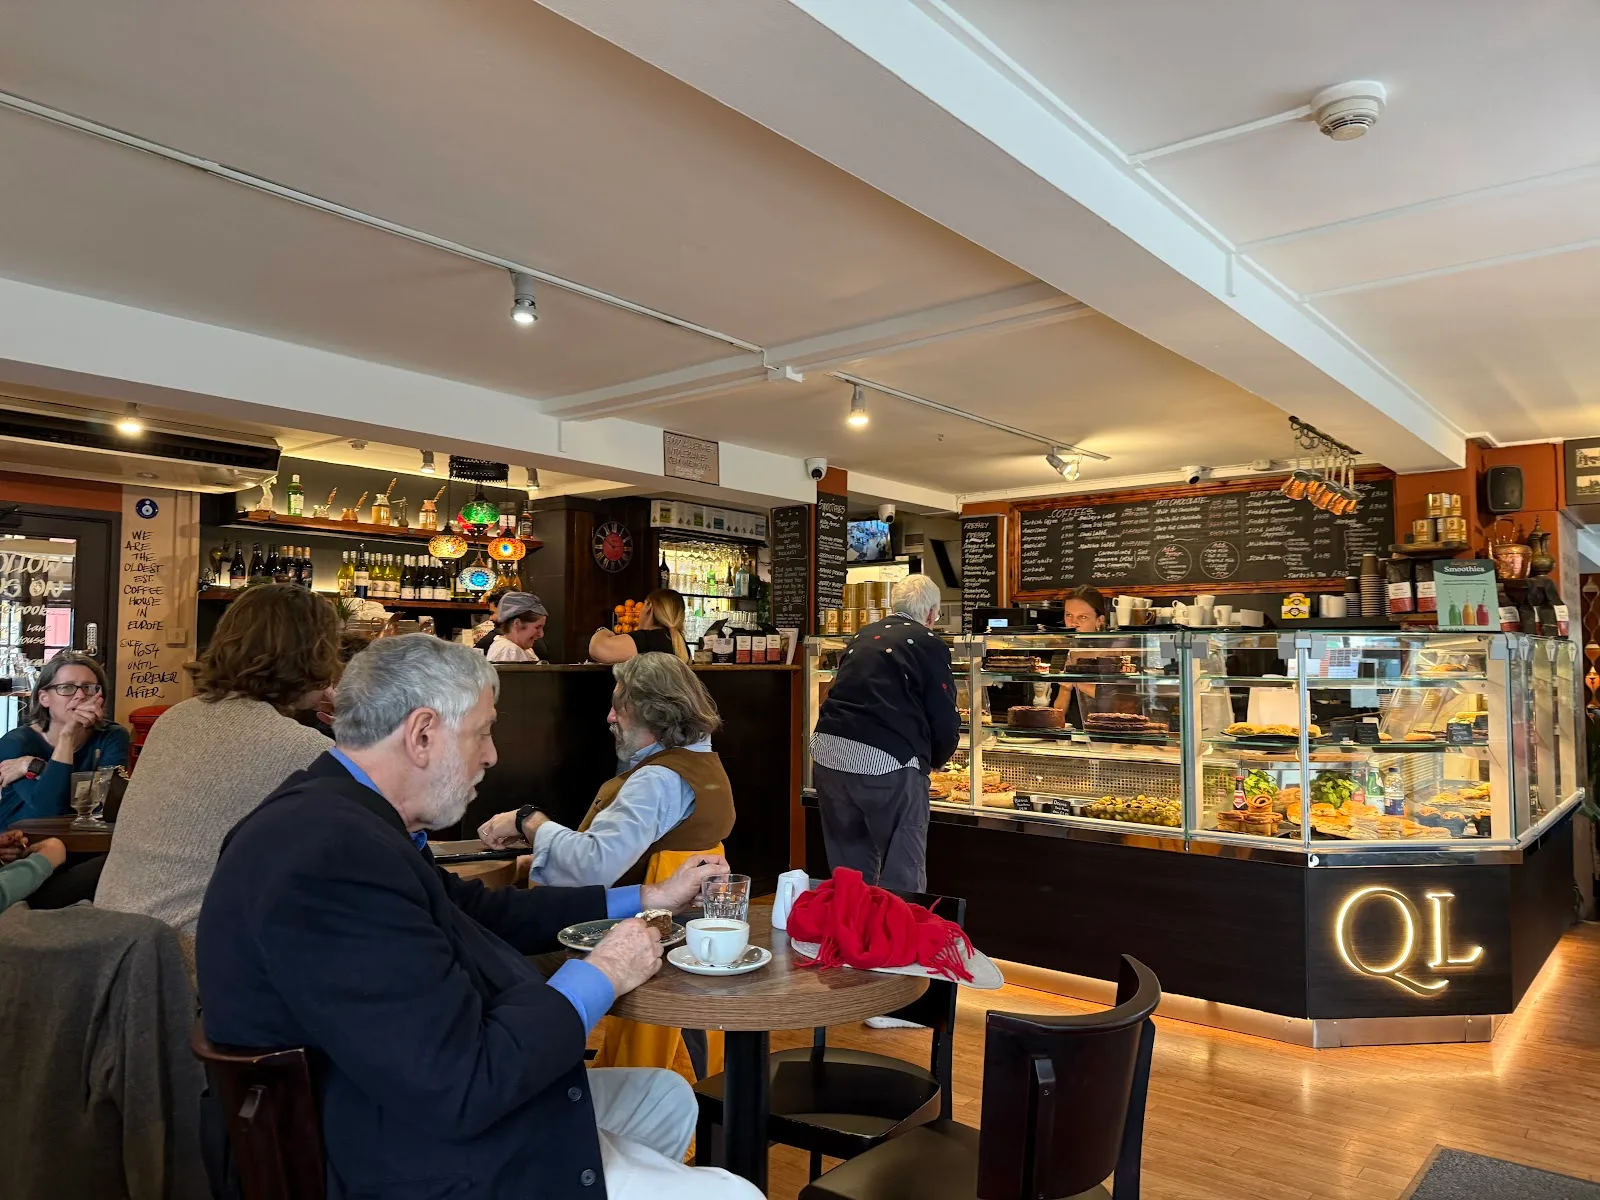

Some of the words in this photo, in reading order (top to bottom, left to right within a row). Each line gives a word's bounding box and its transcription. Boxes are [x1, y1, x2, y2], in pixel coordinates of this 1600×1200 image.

[1169, 497, 1206, 506] CHOCOLATE
[1051, 508, 1095, 518] COFFEES
[132, 530, 154, 540] WE
[125, 541, 151, 551] ARE
[132, 552, 157, 562] THE
[124, 563, 164, 573] OLDEST
[29, 579, 64, 598] ON
[124, 585, 164, 594] COFFEE
[129, 597, 162, 606] HOUSE
[136, 606, 148, 618] IN
[128, 620, 164, 630] EUROPE
[134, 643, 160, 659] 1654
[131, 672, 179, 684] FOREVER
[125, 686, 165, 699] AFTER
[1336, 887, 1484, 998] QL
